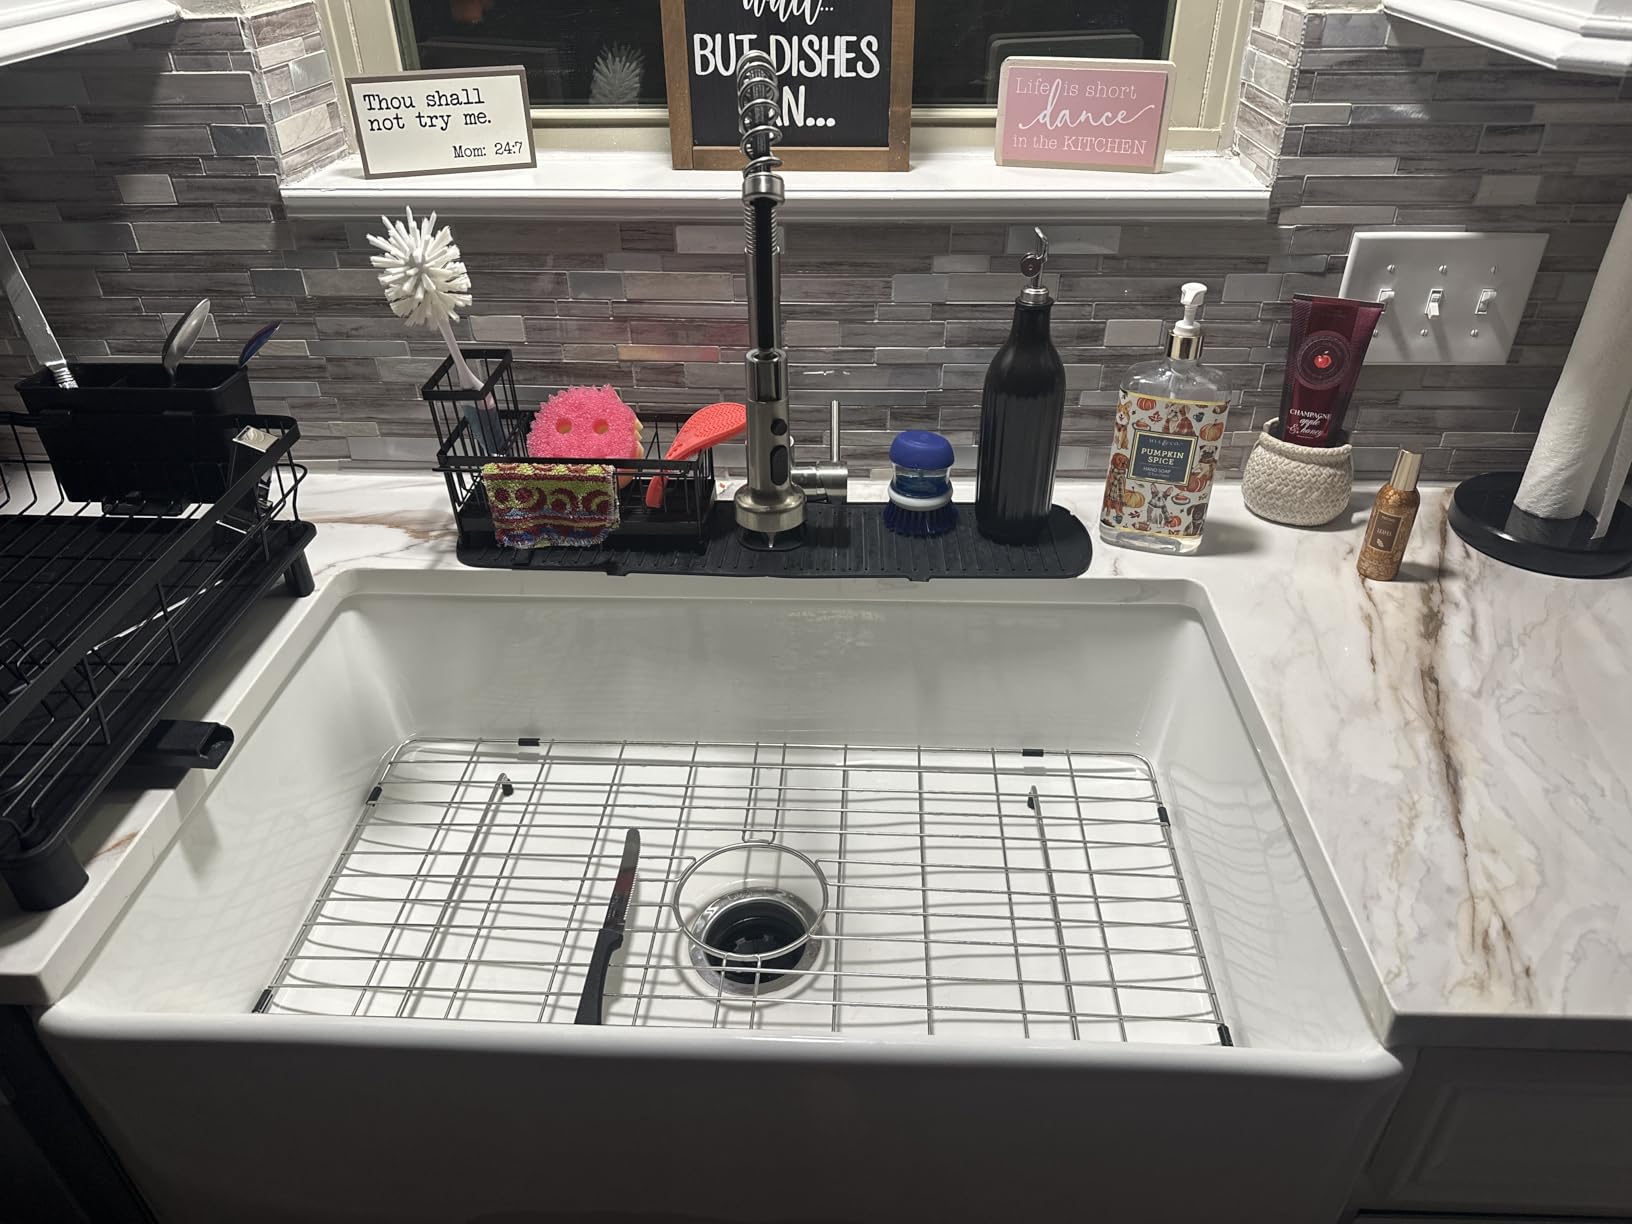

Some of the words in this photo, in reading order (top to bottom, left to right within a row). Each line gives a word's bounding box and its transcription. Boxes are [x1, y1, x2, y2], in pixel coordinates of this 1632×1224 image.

[693, 33, 758, 76] BUT
[769, 34, 881, 79] DISHES
[362, 94, 416, 111] Thou
[426, 88, 485, 108] shall
[1015, 77, 1050, 95] Life
[1063, 80, 1079, 97] is
[1085, 81, 1137, 100] short
[1018, 78, 1155, 130] dance
[367, 113, 405, 131] not
[415, 111, 452, 131] try
[463, 111, 492, 126] me.
[452, 145, 487, 158] Mom:
[494, 141, 523, 155] 24:7
[1012, 133, 1028, 149] in
[1033, 134, 1057, 150] the
[1063, 136, 1148, 155] KITCHEN
[1140, 447, 1185, 459] PUMPKIN
[1147, 456, 1175, 466] SPICE
